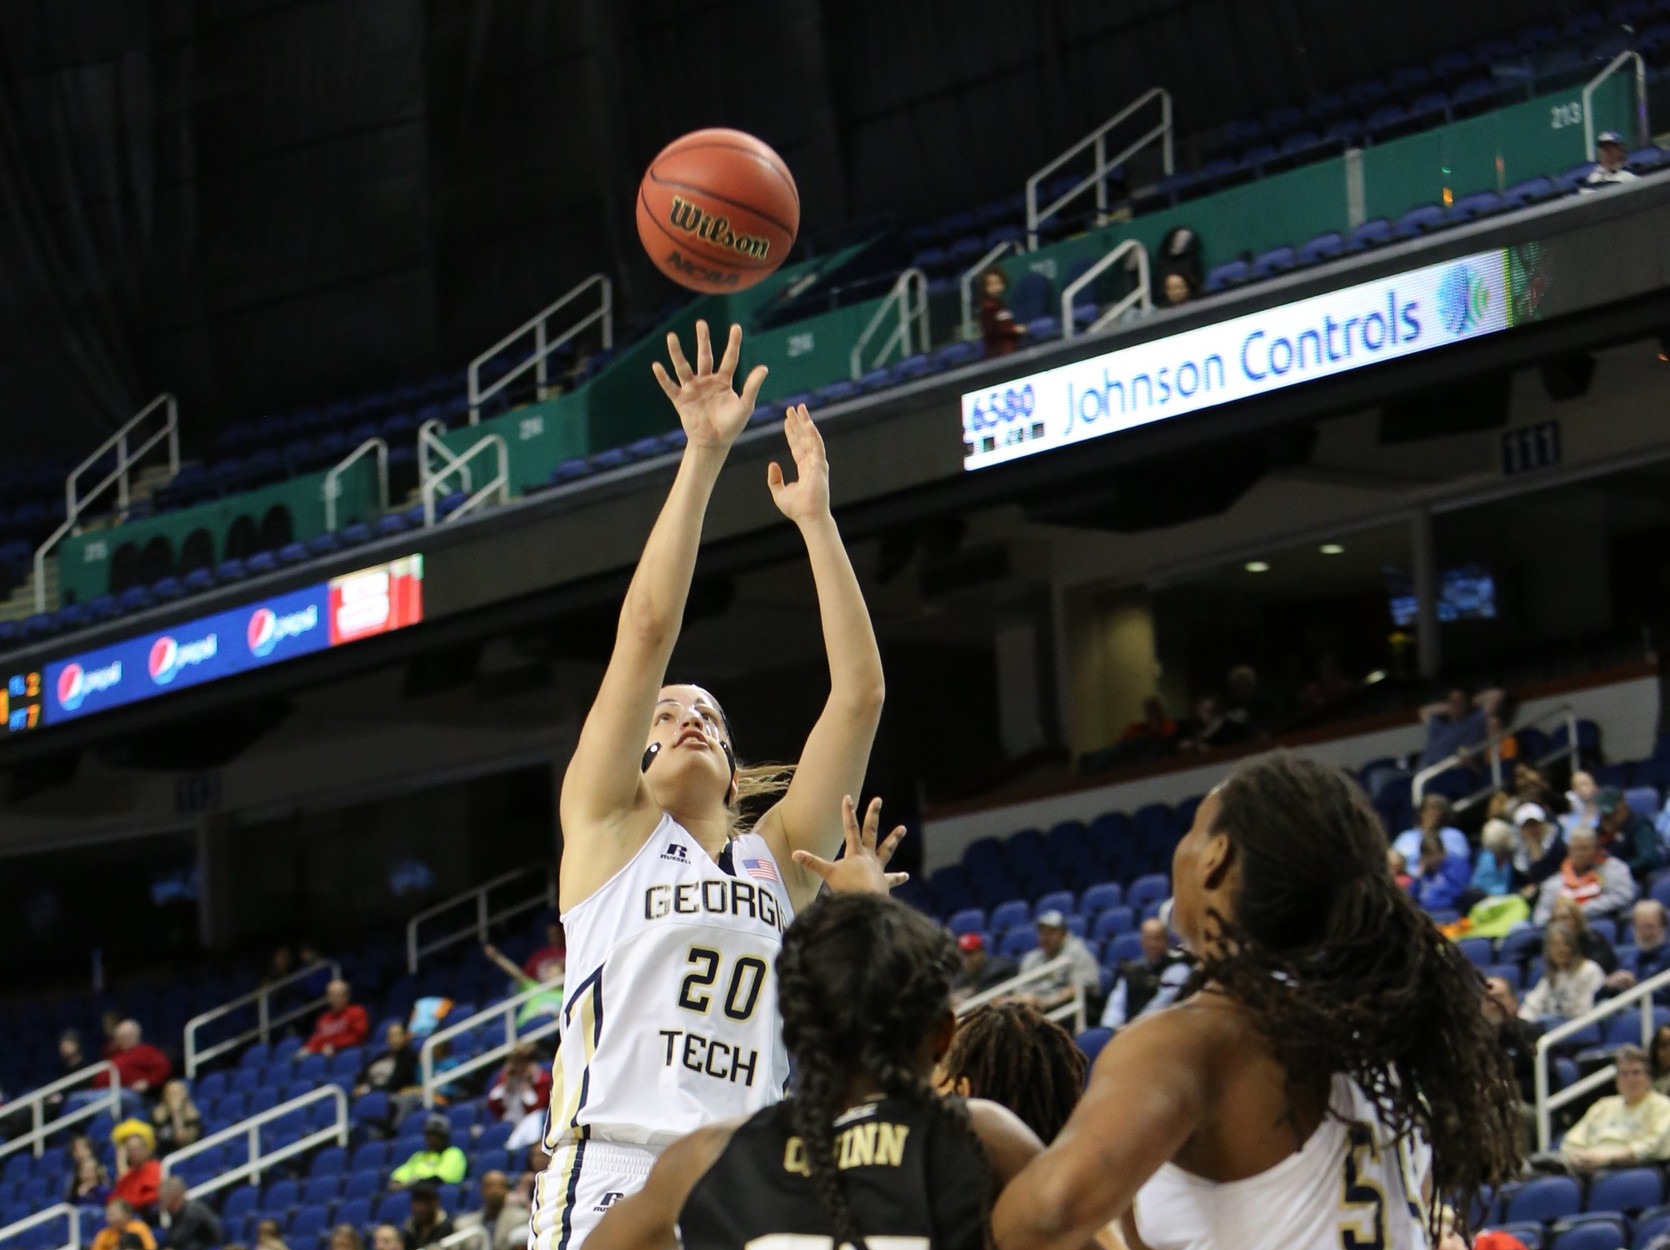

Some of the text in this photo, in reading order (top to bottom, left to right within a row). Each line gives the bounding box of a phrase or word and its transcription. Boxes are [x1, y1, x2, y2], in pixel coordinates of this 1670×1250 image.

[1551, 102, 1582, 129] 213
[670, 195, 770, 259] Wilson
[1063, 289, 1424, 437] Johnson Controls
[676, 945, 768, 1022] 20
[658, 1029, 759, 1088] TECH
[783, 1121, 911, 1178] QINN
